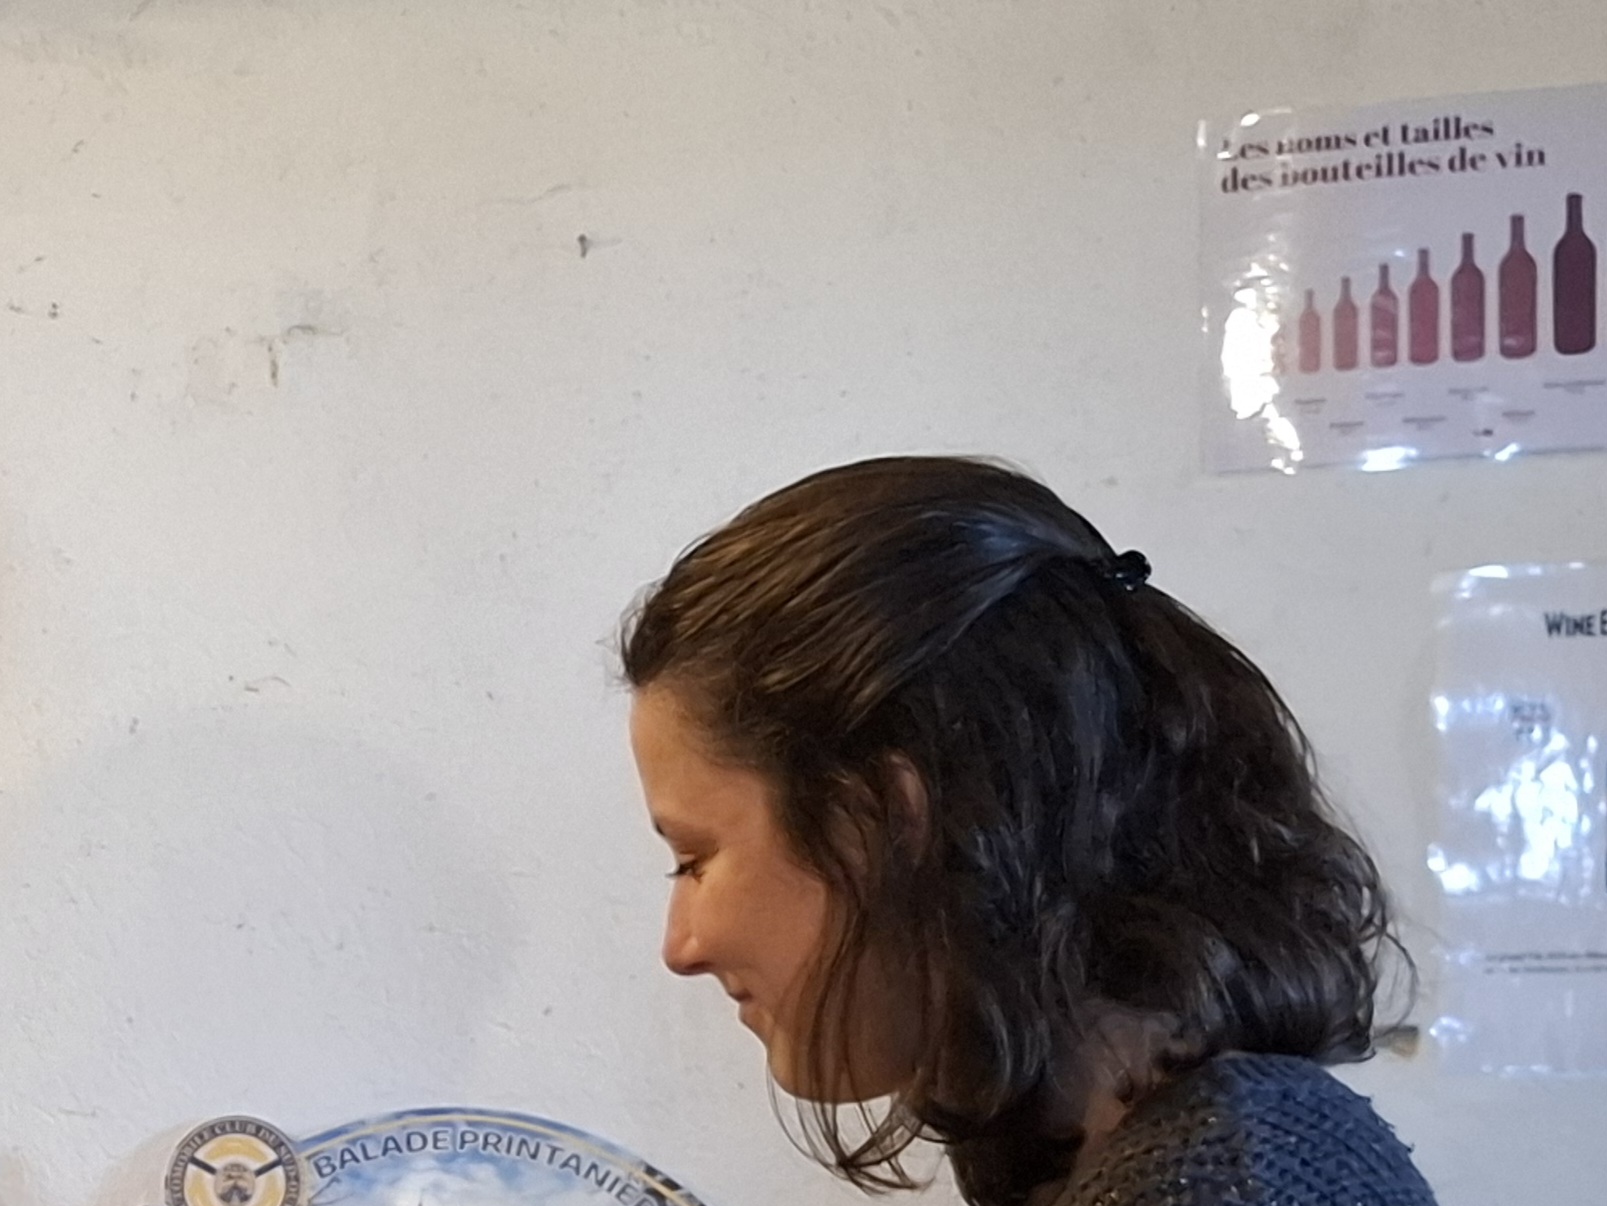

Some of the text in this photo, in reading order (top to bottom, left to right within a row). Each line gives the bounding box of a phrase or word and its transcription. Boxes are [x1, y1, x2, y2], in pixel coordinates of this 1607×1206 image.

[1363, 124, 1391, 147] et
[1400, 116, 1495, 145] tailles
[1221, 142, 1546, 193] des bouteilles de vin
[1543, 611, 1597, 638] WINE
[213, 1121, 257, 1136] CLUB
[312, 1127, 451, 1181] BALADE
